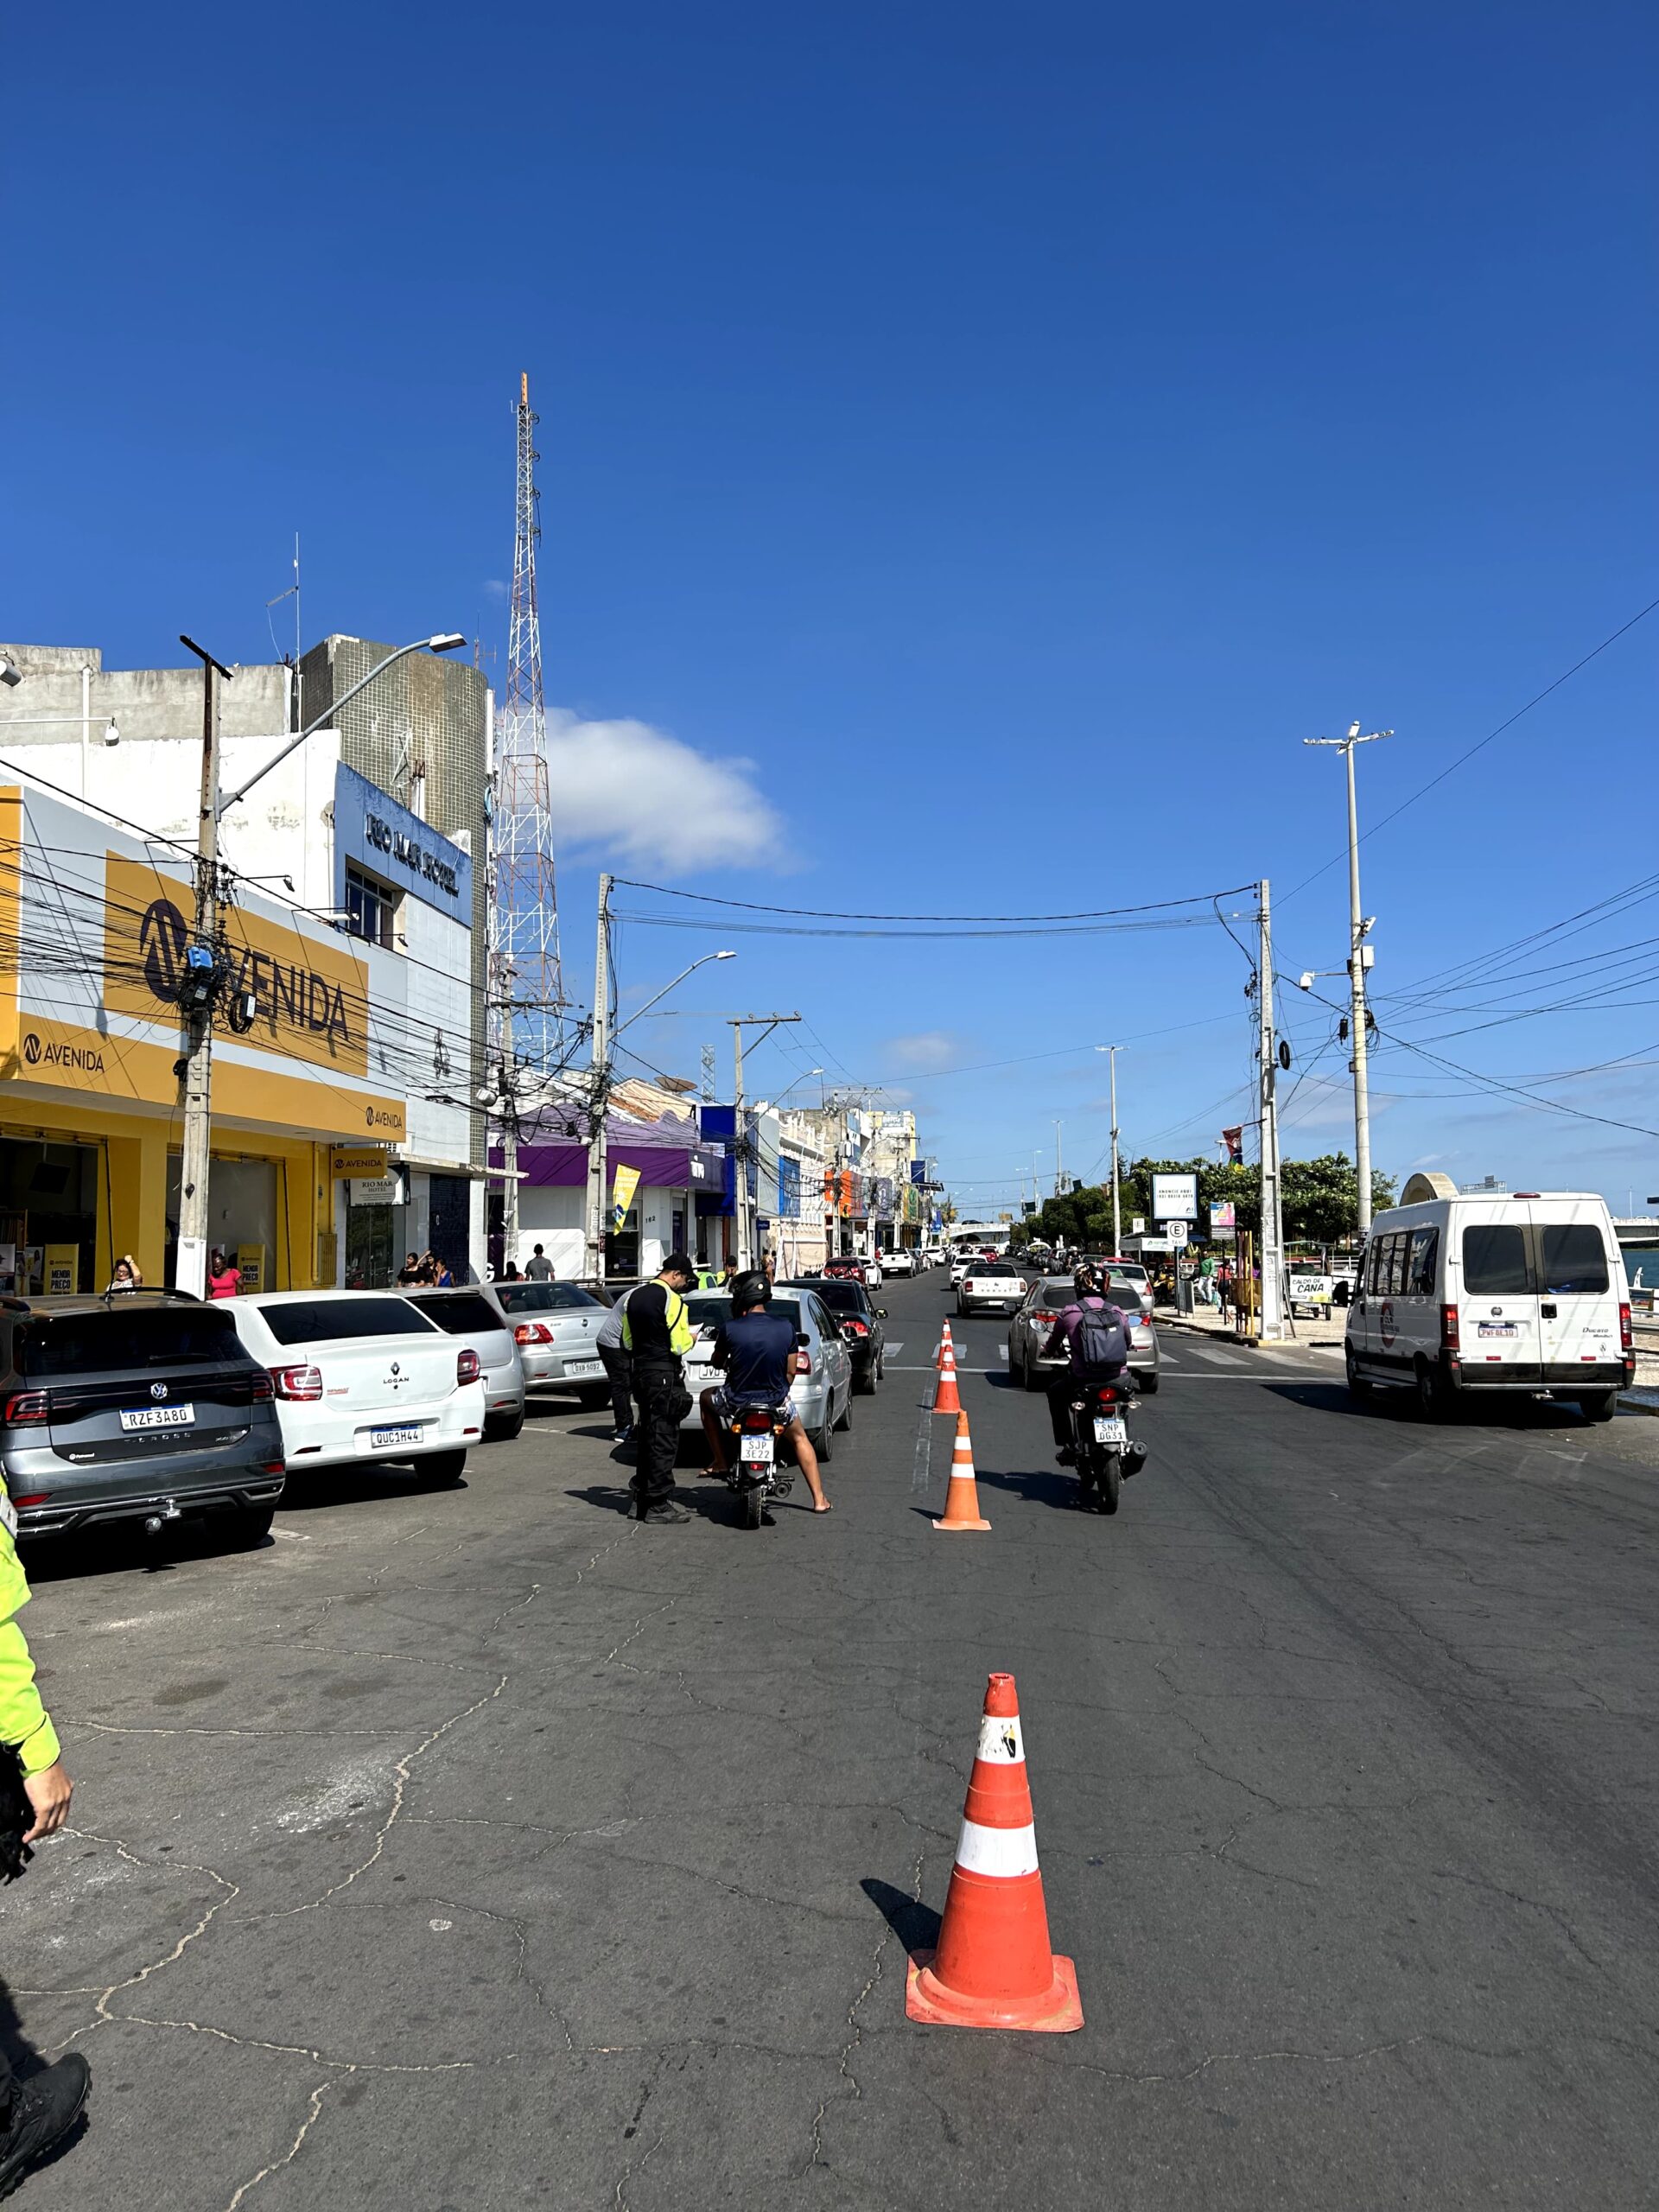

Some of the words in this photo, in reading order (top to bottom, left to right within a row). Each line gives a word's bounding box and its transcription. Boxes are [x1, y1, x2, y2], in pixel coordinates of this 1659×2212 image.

[216, 944, 349, 1040] VENIDA
[43, 1042, 105, 1073] AVENIDA
[375, 1111, 403, 1128] AVENIDA
[346, 1159, 382, 1168] AVENIDA
[1174, 1225, 1180, 1235] E
[52, 1269, 71, 1279] MENOR
[1298, 1283, 1324, 1293] CANA
[1101, 1423, 1119, 1432] SNP
[377, 1431, 419, 1445] QUC1H44
[748, 1441, 767, 1450] SJP
[745, 1450, 771, 1459] 3E22
